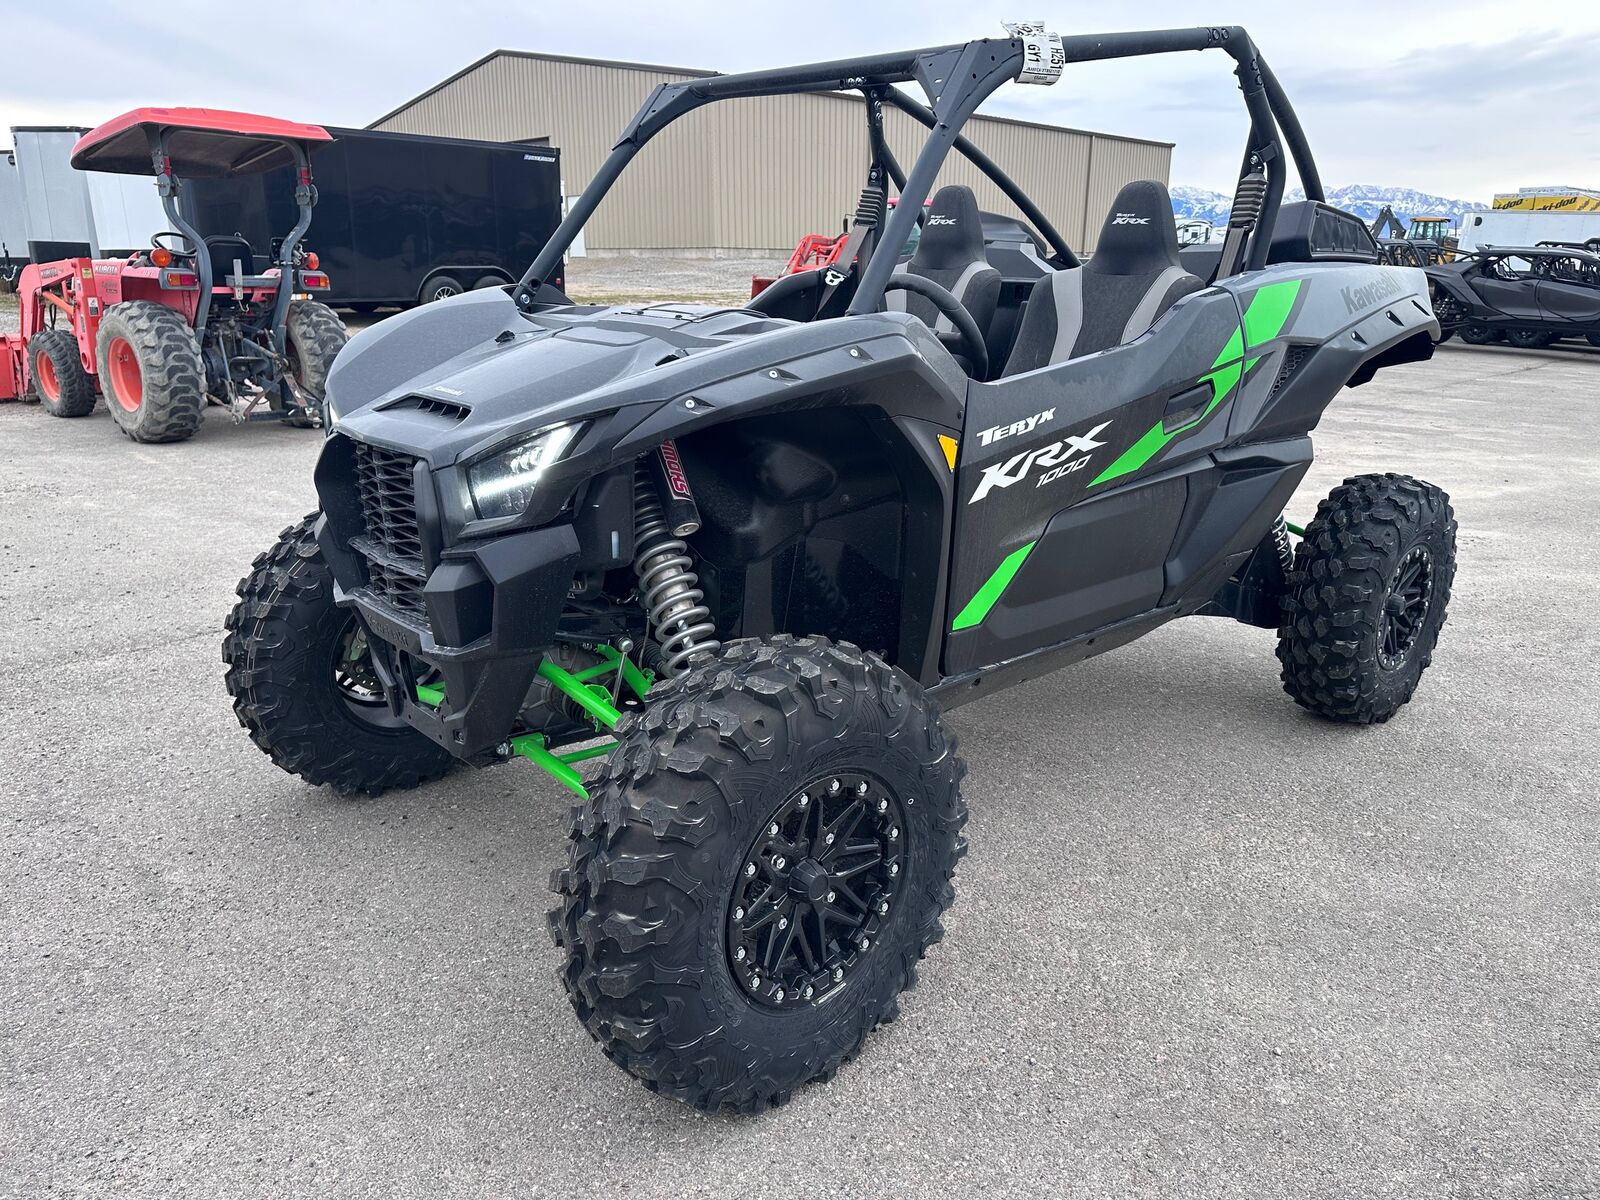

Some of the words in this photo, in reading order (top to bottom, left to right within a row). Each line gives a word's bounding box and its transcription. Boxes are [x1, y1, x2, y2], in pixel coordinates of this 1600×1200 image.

[1027, 44, 1041, 62] GY1
[1050, 47, 1064, 69] H251
[927, 218, 957, 226] KRX
[1111, 217, 1151, 225] KRX
[1340, 270, 1402, 315] Kawasaki
[976, 407, 1056, 447] TERYX
[968, 419, 1114, 505] KRX
[1036, 454, 1093, 488] 1000
